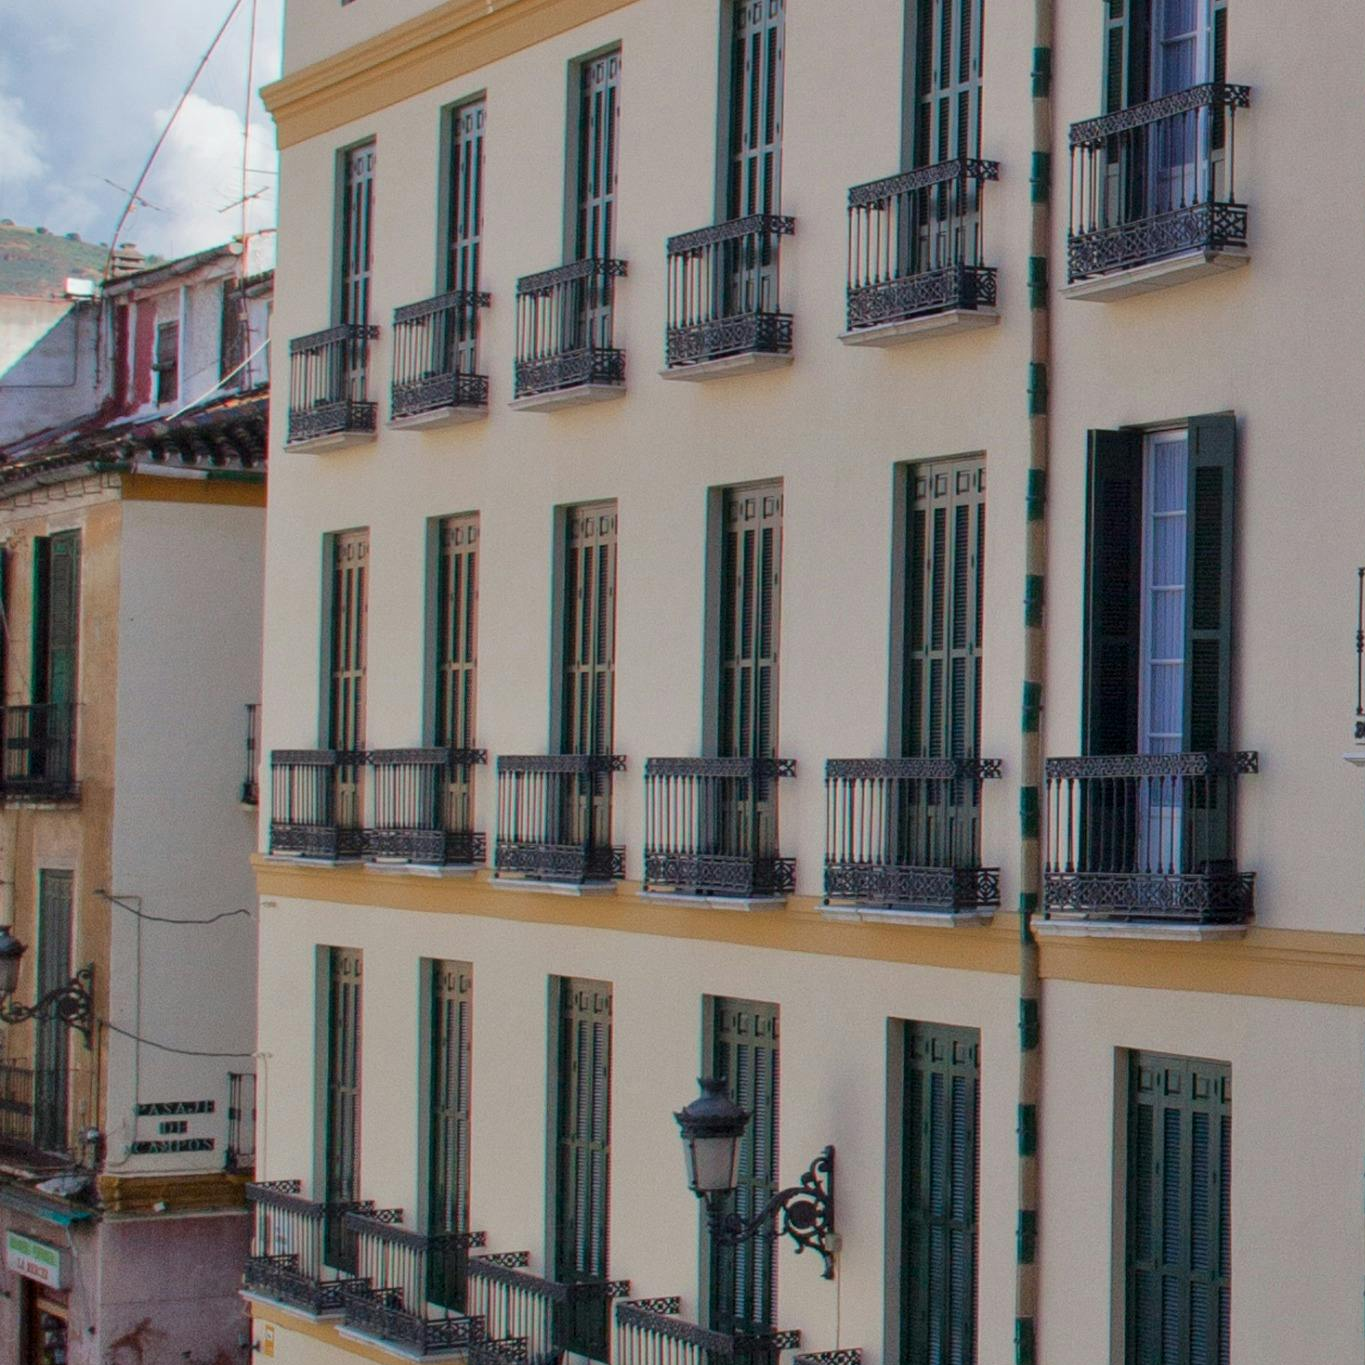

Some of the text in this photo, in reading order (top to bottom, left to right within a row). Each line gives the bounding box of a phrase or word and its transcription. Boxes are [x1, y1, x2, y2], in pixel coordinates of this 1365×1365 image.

[137, 1101, 215, 1115] PASAJE
[160, 1121, 188, 1134] DE
[131, 1138, 215, 1154] CAMPOS
